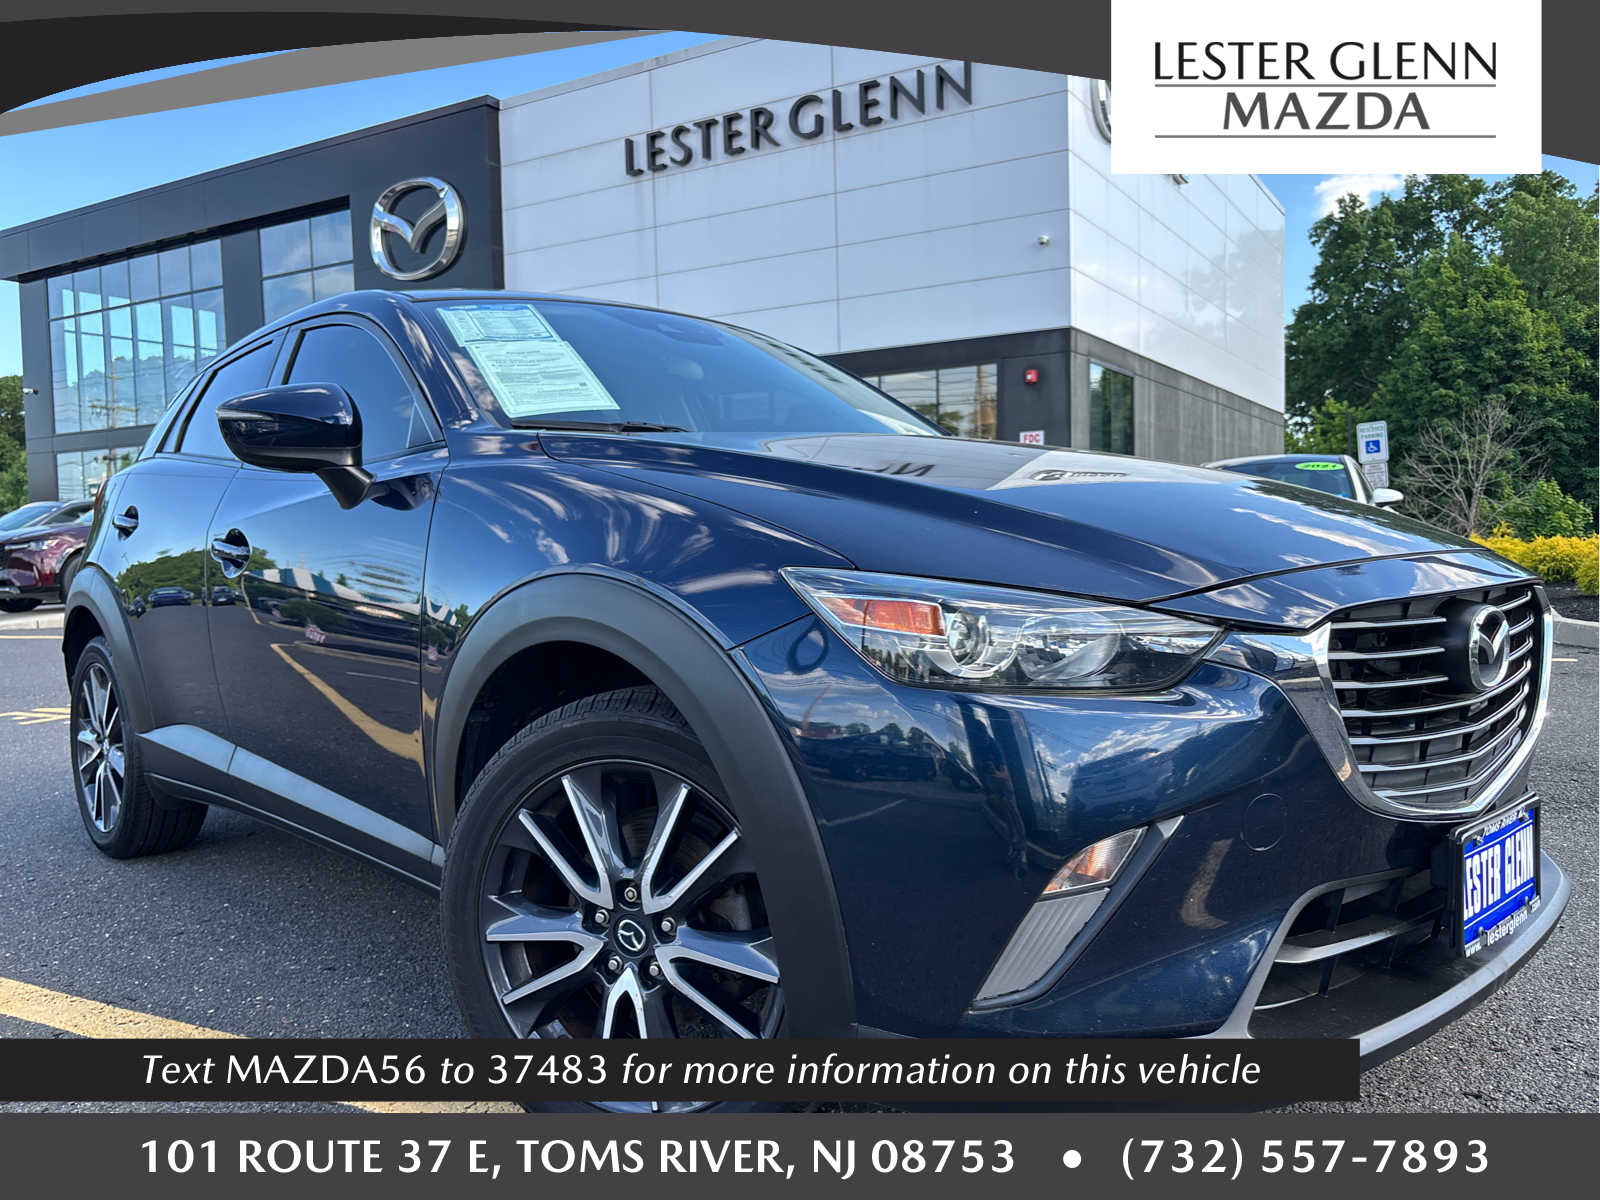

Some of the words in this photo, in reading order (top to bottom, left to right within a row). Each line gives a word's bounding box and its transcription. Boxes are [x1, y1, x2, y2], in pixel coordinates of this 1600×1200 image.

[624, 106, 781, 178] LESTER
[788, 61, 973, 140] GLENN
[1023, 433, 1041, 443] FDC
[1504, 823, 1534, 895] GLENN
